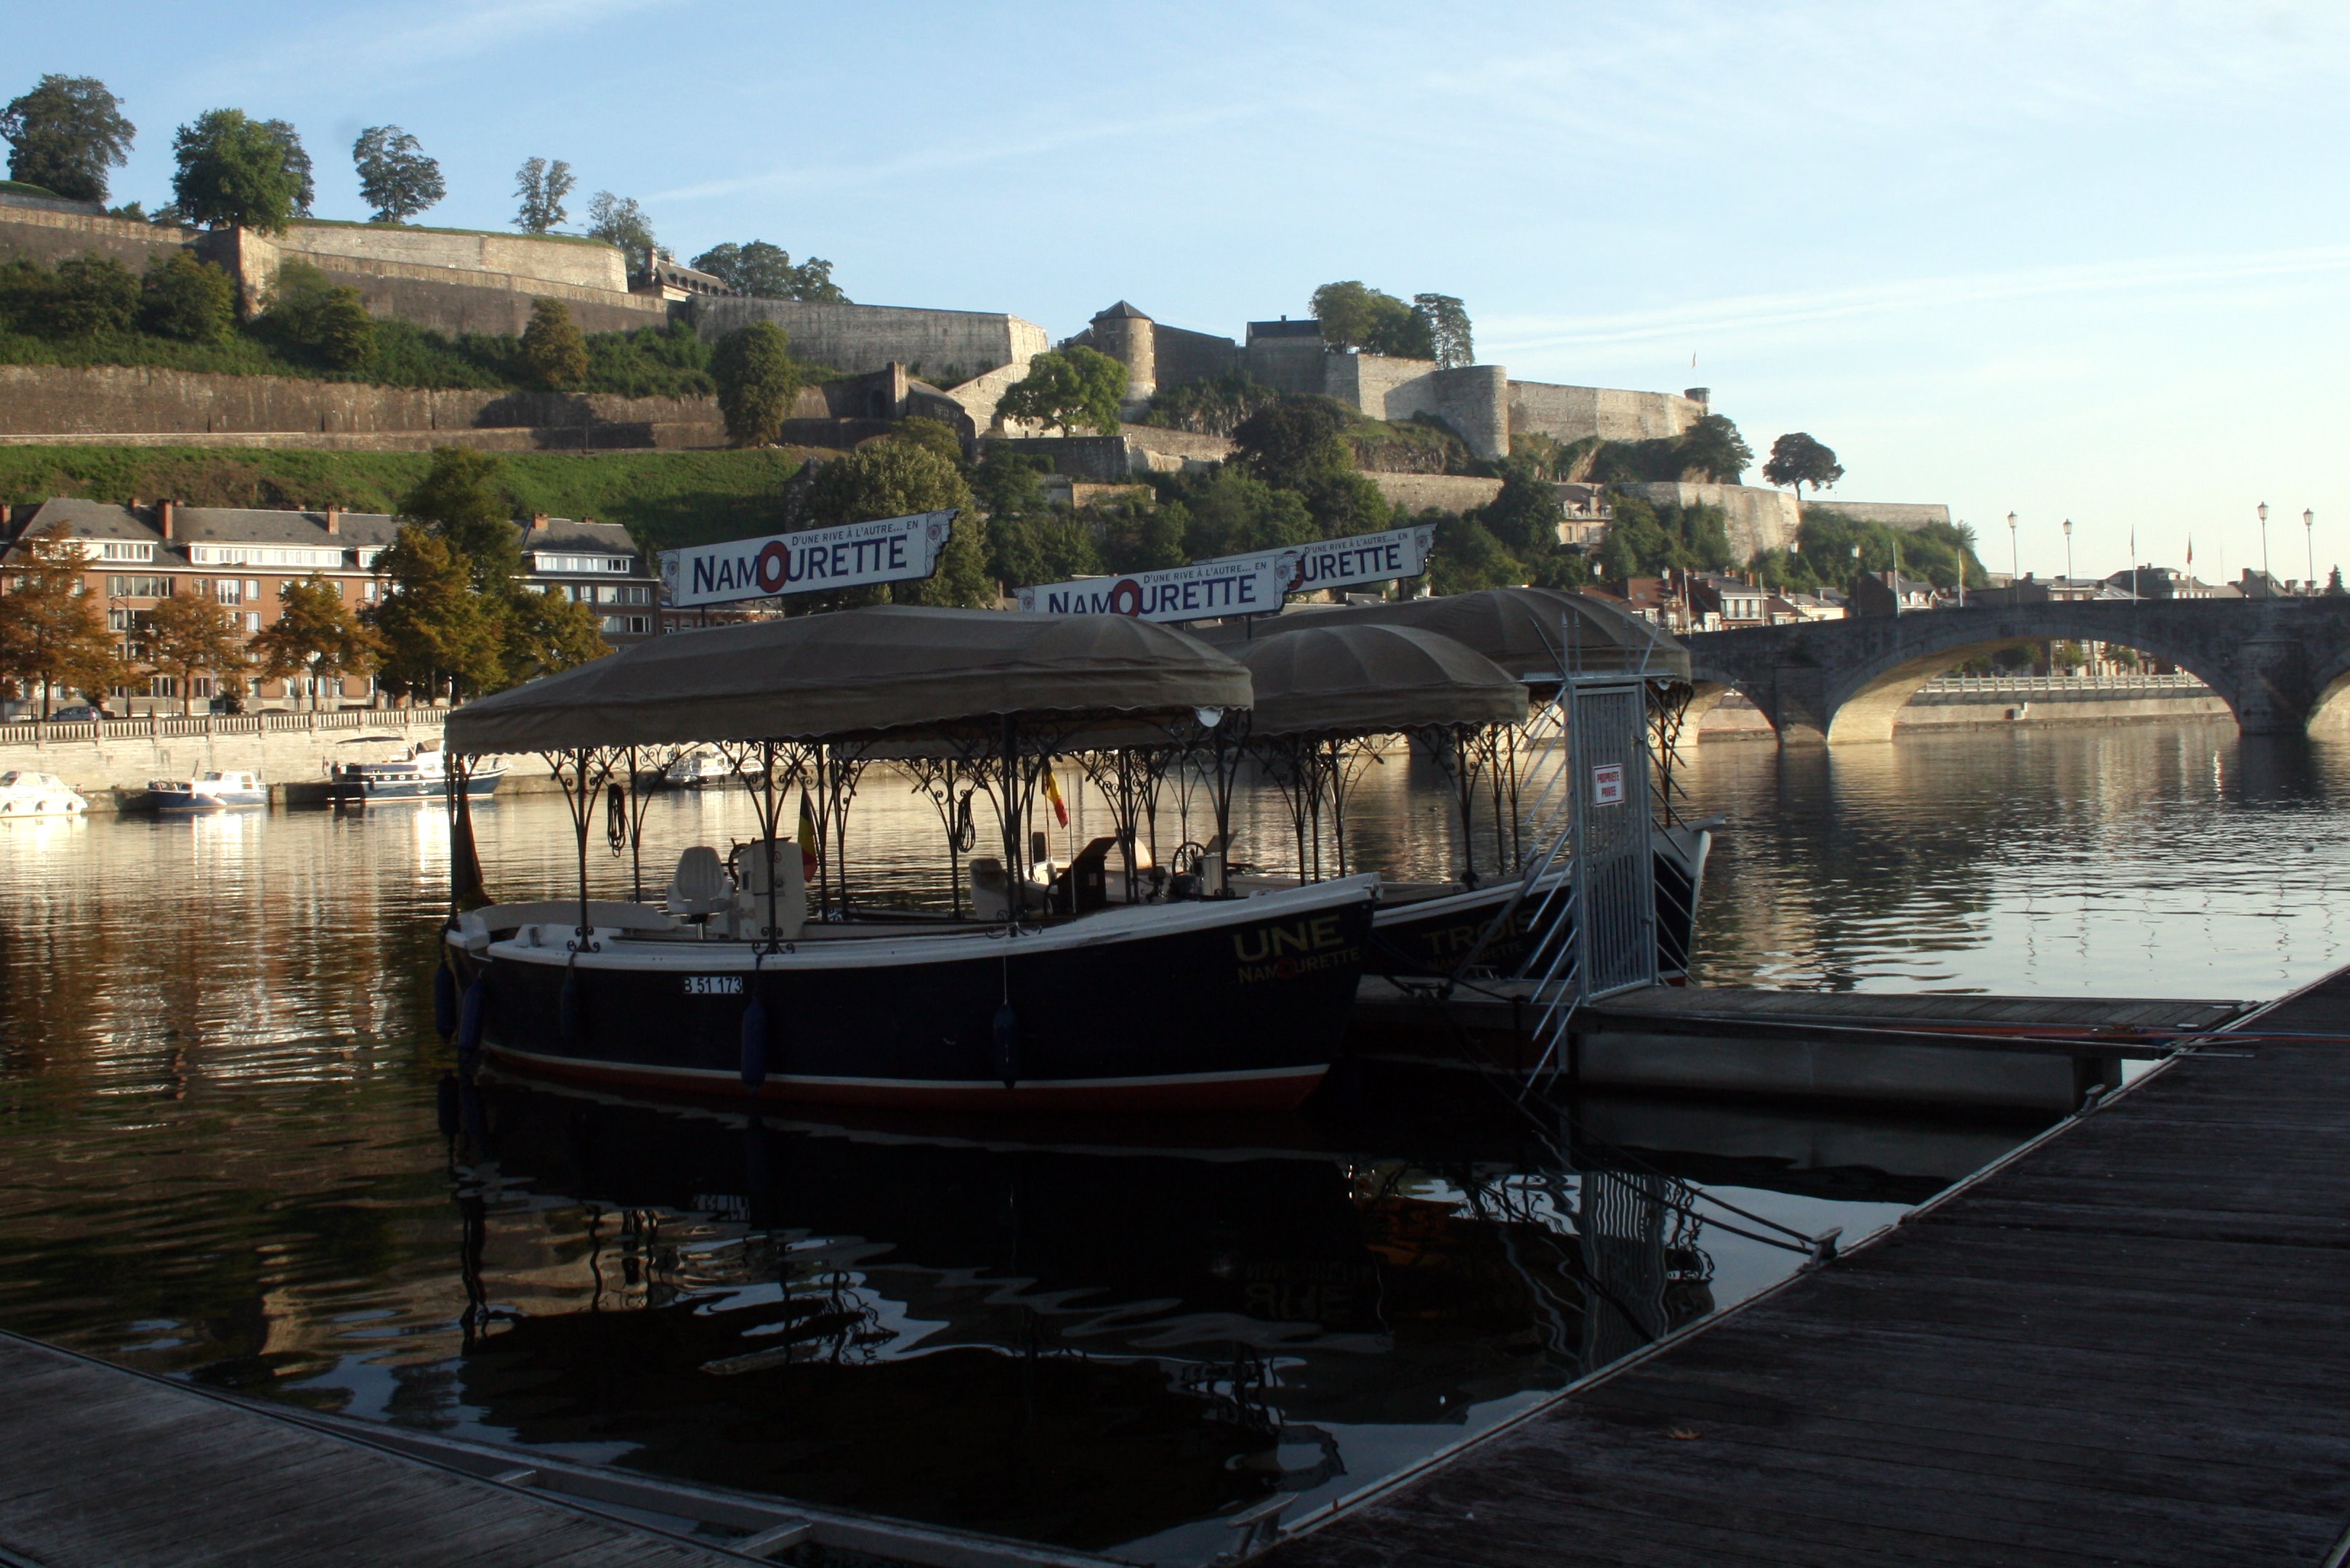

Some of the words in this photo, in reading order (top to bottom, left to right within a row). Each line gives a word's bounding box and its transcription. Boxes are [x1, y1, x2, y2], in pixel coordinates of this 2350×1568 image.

[792, 534, 819, 546] D'UNE
[823, 530, 844, 542] RIVE
[847, 527, 853, 538] À
[855, 523, 903, 538] L'AUTRE...
[906, 520, 918, 530] EN
[1304, 545, 1327, 554] D'UNE
[1329, 541, 1349, 551] RIVE
[1349, 538, 1354, 547] À
[1356, 535, 1395, 546] L'AUTRE...
[692, 534, 908, 594] NAMOURETTE
[1144, 573, 1171, 584] D'UNE
[1174, 570, 1194, 581] RIVE
[1197, 567, 1203, 578] À
[1206, 565, 1251, 576] L'AUTRE...
[1255, 562, 1267, 570] EN
[1232, 913, 1344, 962] UNE
[1421, 909, 1542, 954] TROIS
[1237, 945, 1360, 985] NAMOURETTE
[1426, 940, 1525, 970] NAMRETTE
[684, 977, 693, 993] B
[698, 977, 711, 993] 51
[718, 977, 742, 993] 173
